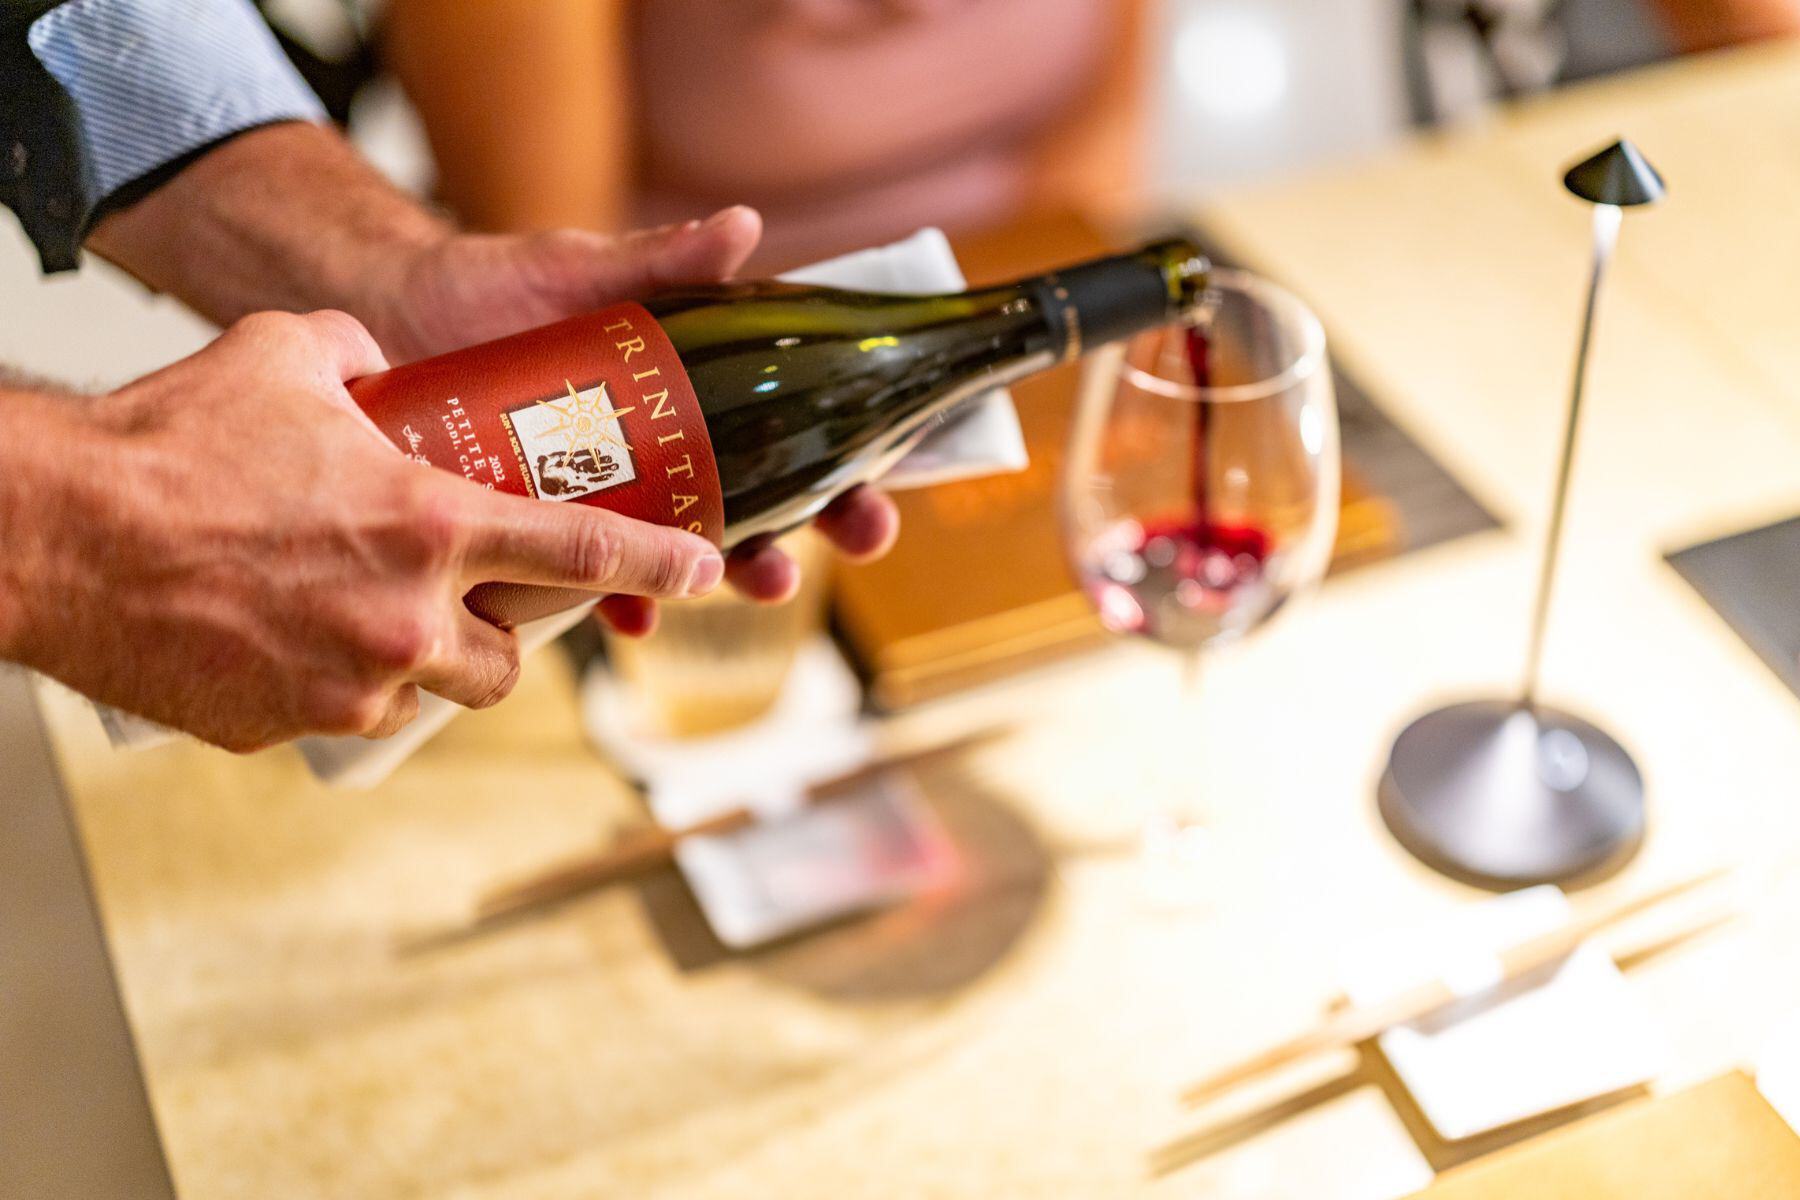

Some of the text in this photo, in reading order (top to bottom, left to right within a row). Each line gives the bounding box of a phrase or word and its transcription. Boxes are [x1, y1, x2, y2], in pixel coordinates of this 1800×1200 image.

[446, 397, 487, 470] PETITE
[603, 318, 704, 536] TRINITAS
[459, 454, 474, 479] CAL
[488, 455, 505, 482] 2022
